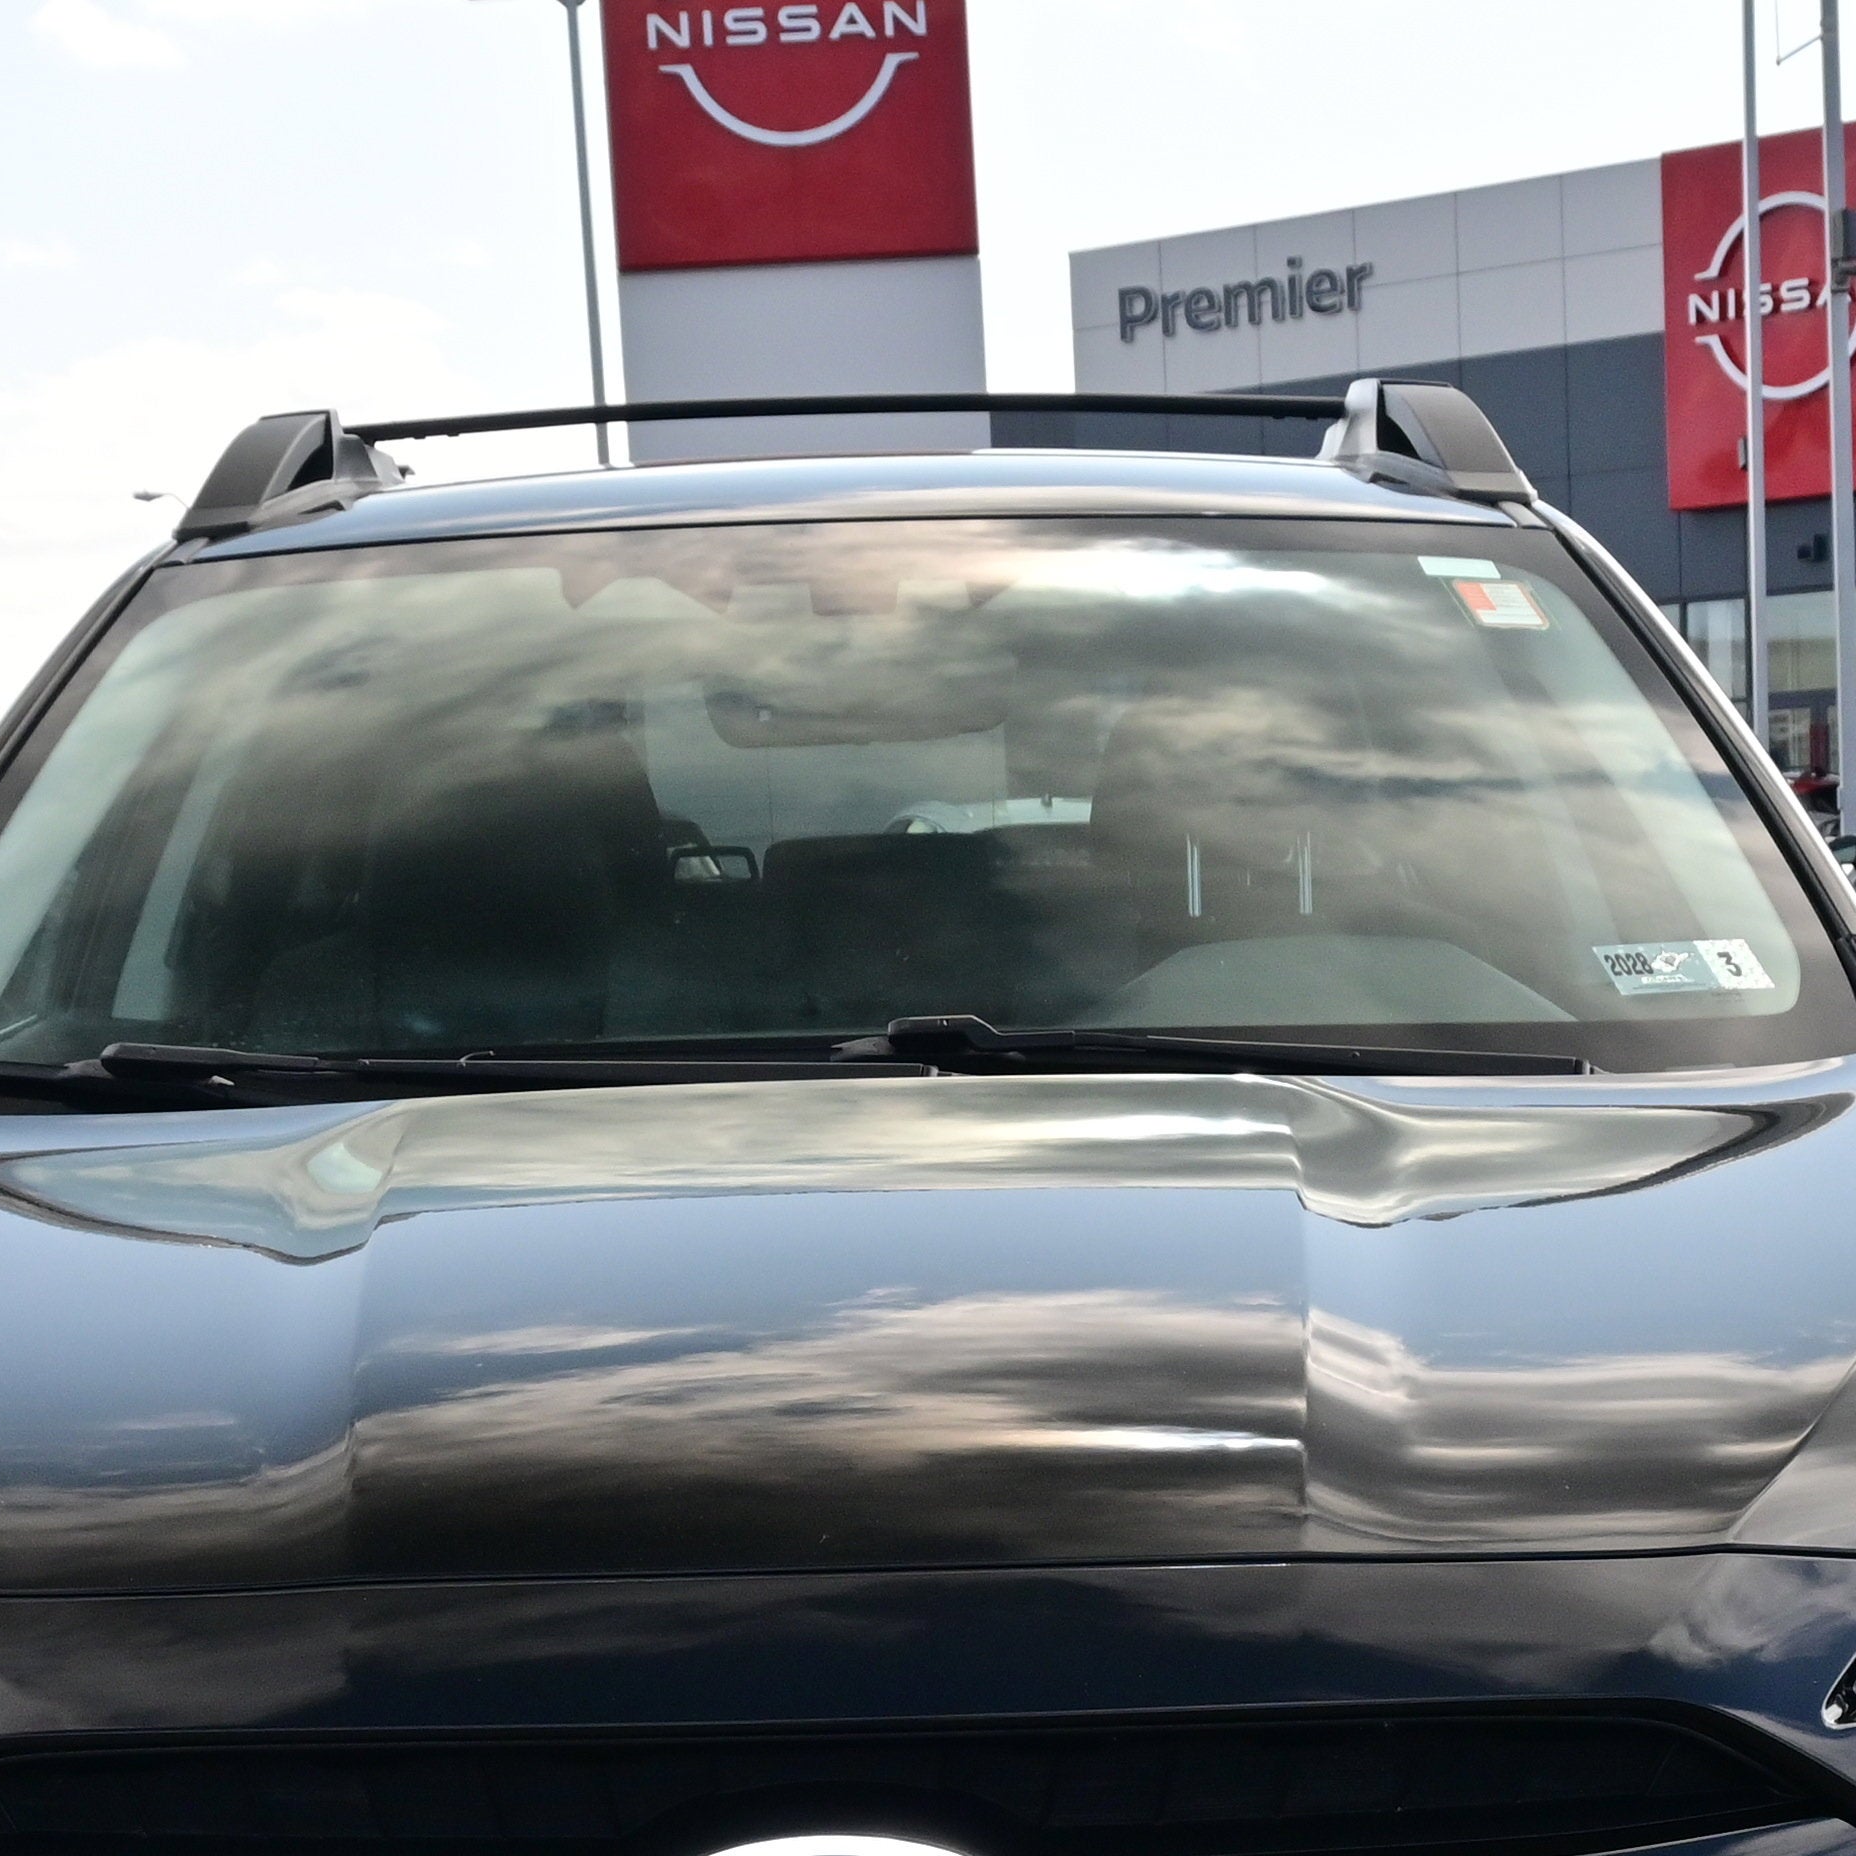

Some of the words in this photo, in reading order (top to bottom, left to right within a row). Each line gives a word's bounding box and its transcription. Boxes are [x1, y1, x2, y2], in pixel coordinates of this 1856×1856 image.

[646, 0, 928, 50] NISSAN
[1118, 255, 1374, 343] Premier
[1604, 952, 1654, 977] 2028
[1717, 952, 1742, 977] 3
